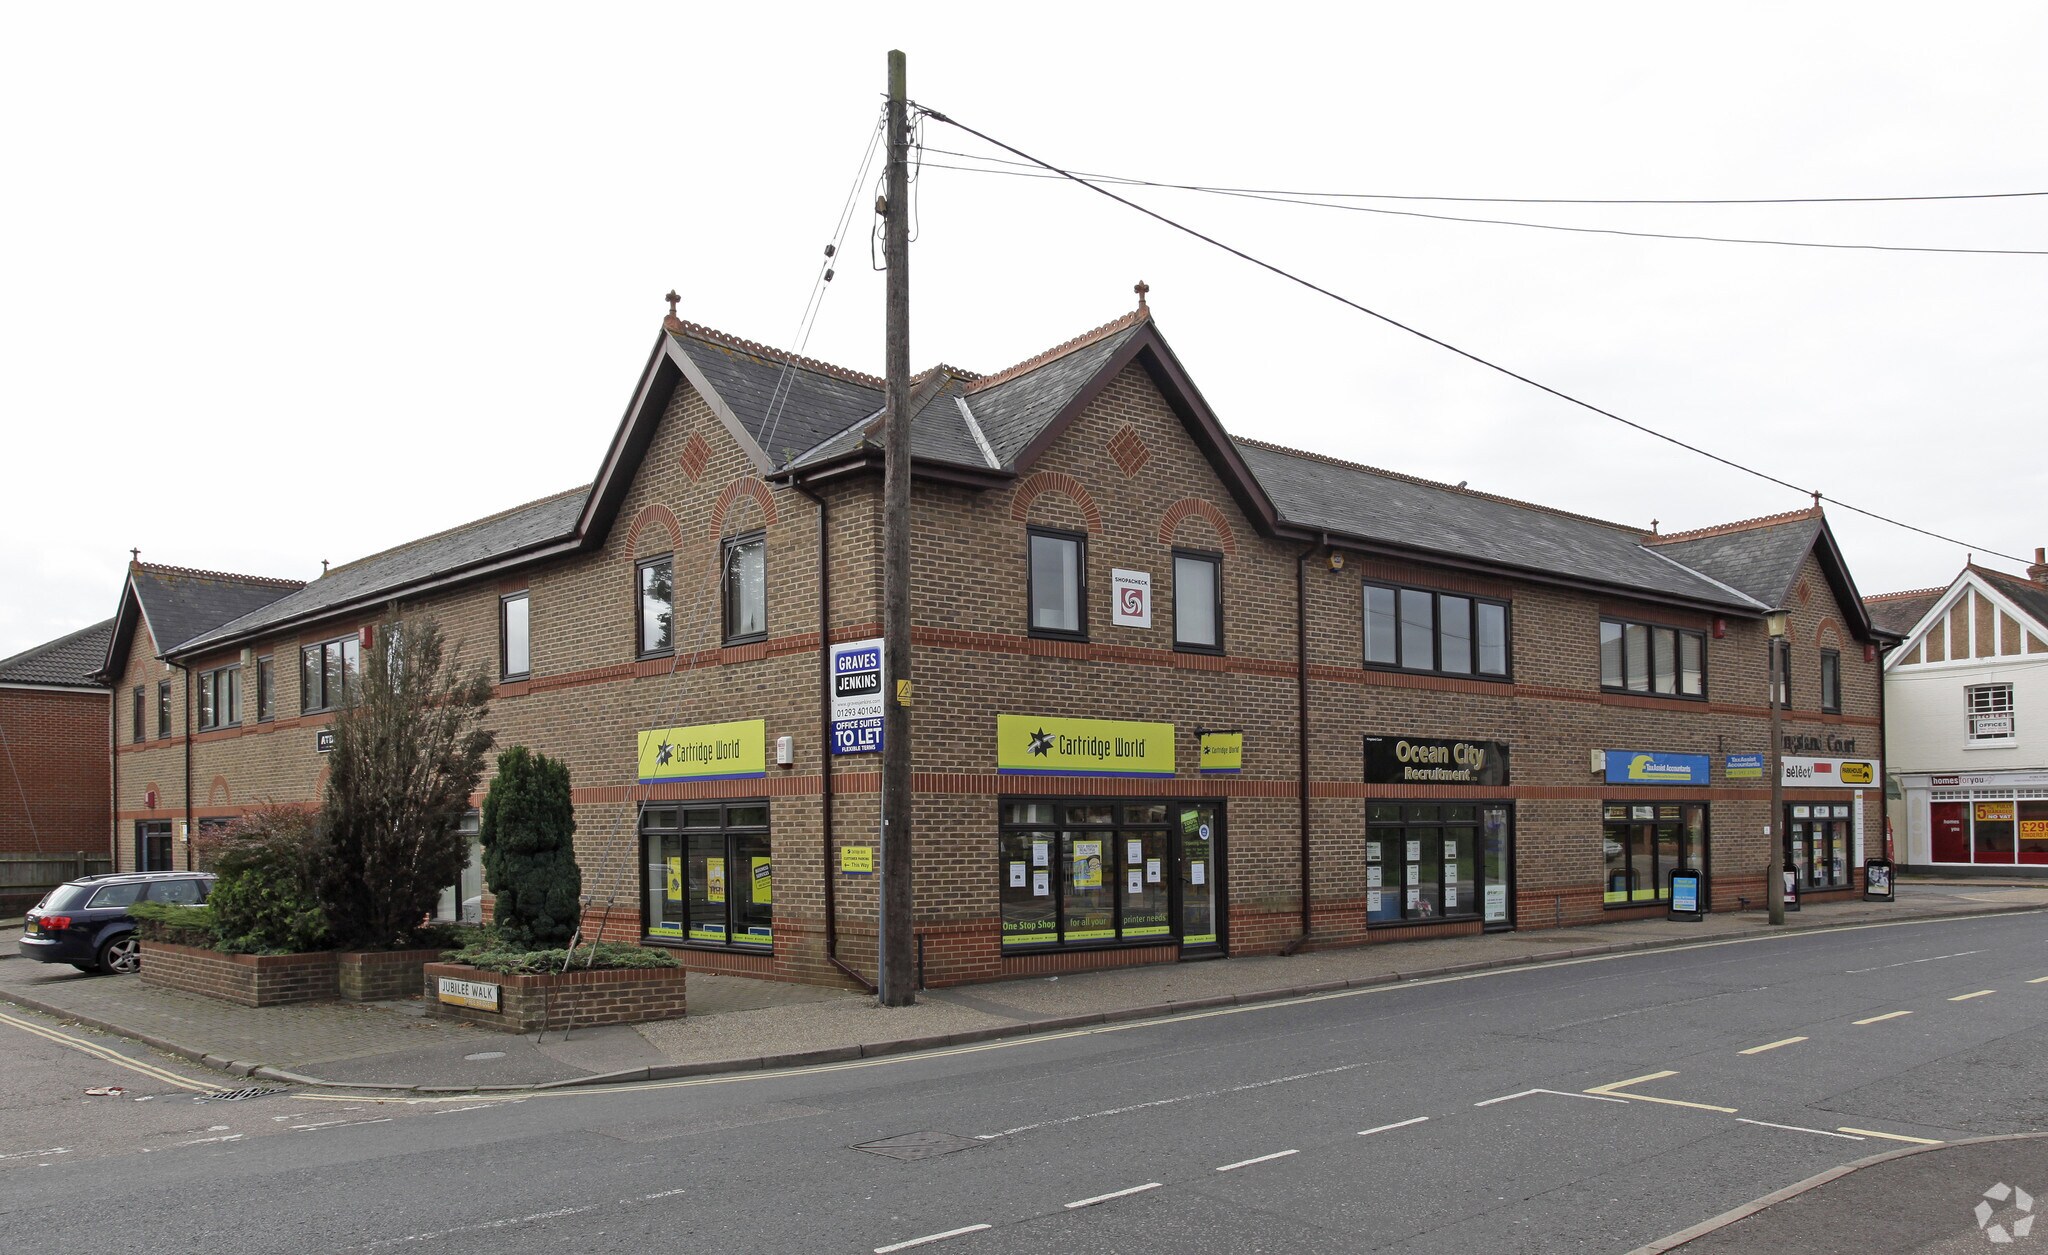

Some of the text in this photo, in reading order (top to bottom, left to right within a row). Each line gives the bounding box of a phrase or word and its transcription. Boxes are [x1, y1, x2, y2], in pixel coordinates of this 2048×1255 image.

[1115, 577, 1147, 585] SHOPACHECK
[839, 653, 877, 670] GRAVES
[839, 674, 877, 690] JENKINS
[837, 705, 881, 717] 01293 401040
[836, 719, 881, 730] OFFICE SUITES
[835, 728, 882, 746] TO LET
[676, 739, 741, 765] Cartridge World
[1059, 734, 1145, 760] Cartridge World
[1395, 740, 1485, 770] Ocean City
[1404, 766, 1471, 781] Recruitment
[1003, 920, 1056, 931] One Stop Shop
[1070, 918, 1106, 927] for all your
[1124, 914, 1167, 925] printer needs
[442, 981, 493, 999] JUBILEE WALK
